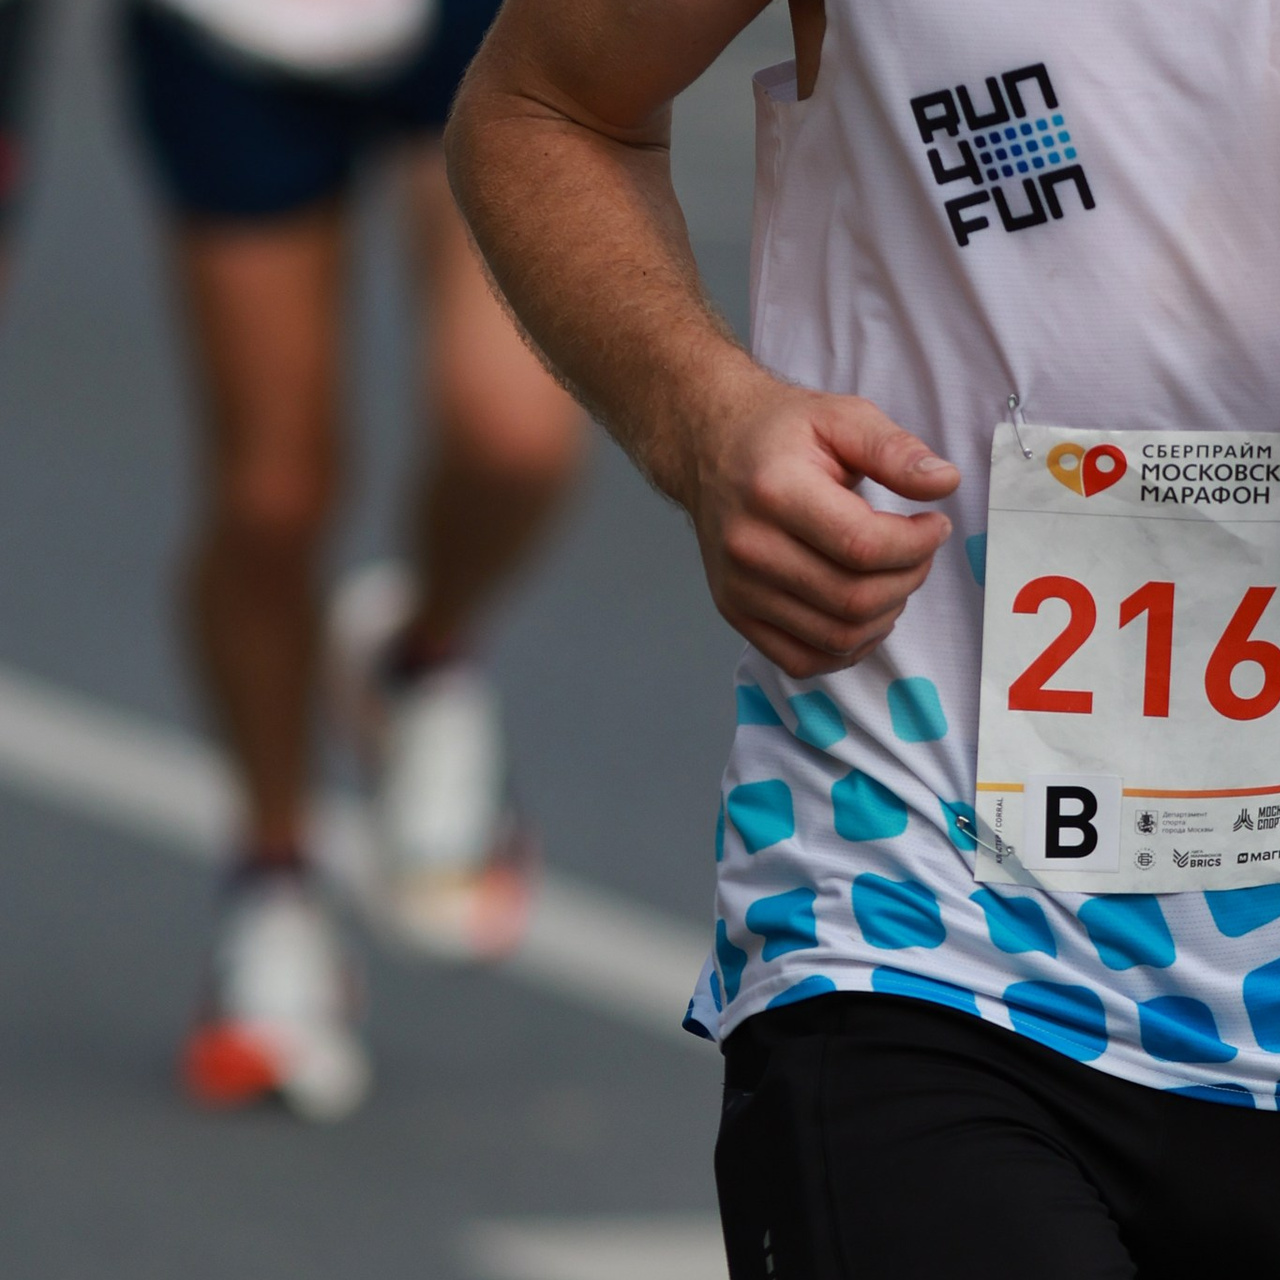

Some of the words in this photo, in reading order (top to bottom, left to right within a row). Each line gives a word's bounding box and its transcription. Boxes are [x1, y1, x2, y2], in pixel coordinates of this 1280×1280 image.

[910, 62, 1059, 144] RUN
[927, 140, 984, 185] 4
[944, 164, 1096, 247] FUN
[1142, 442, 1272, 459] СБЕРПРАЙМ
[1140, 486, 1270, 504] МАРАФОН
[1162, 811, 1208, 819] Департамент
[1190, 857, 1222, 868] BRICS
